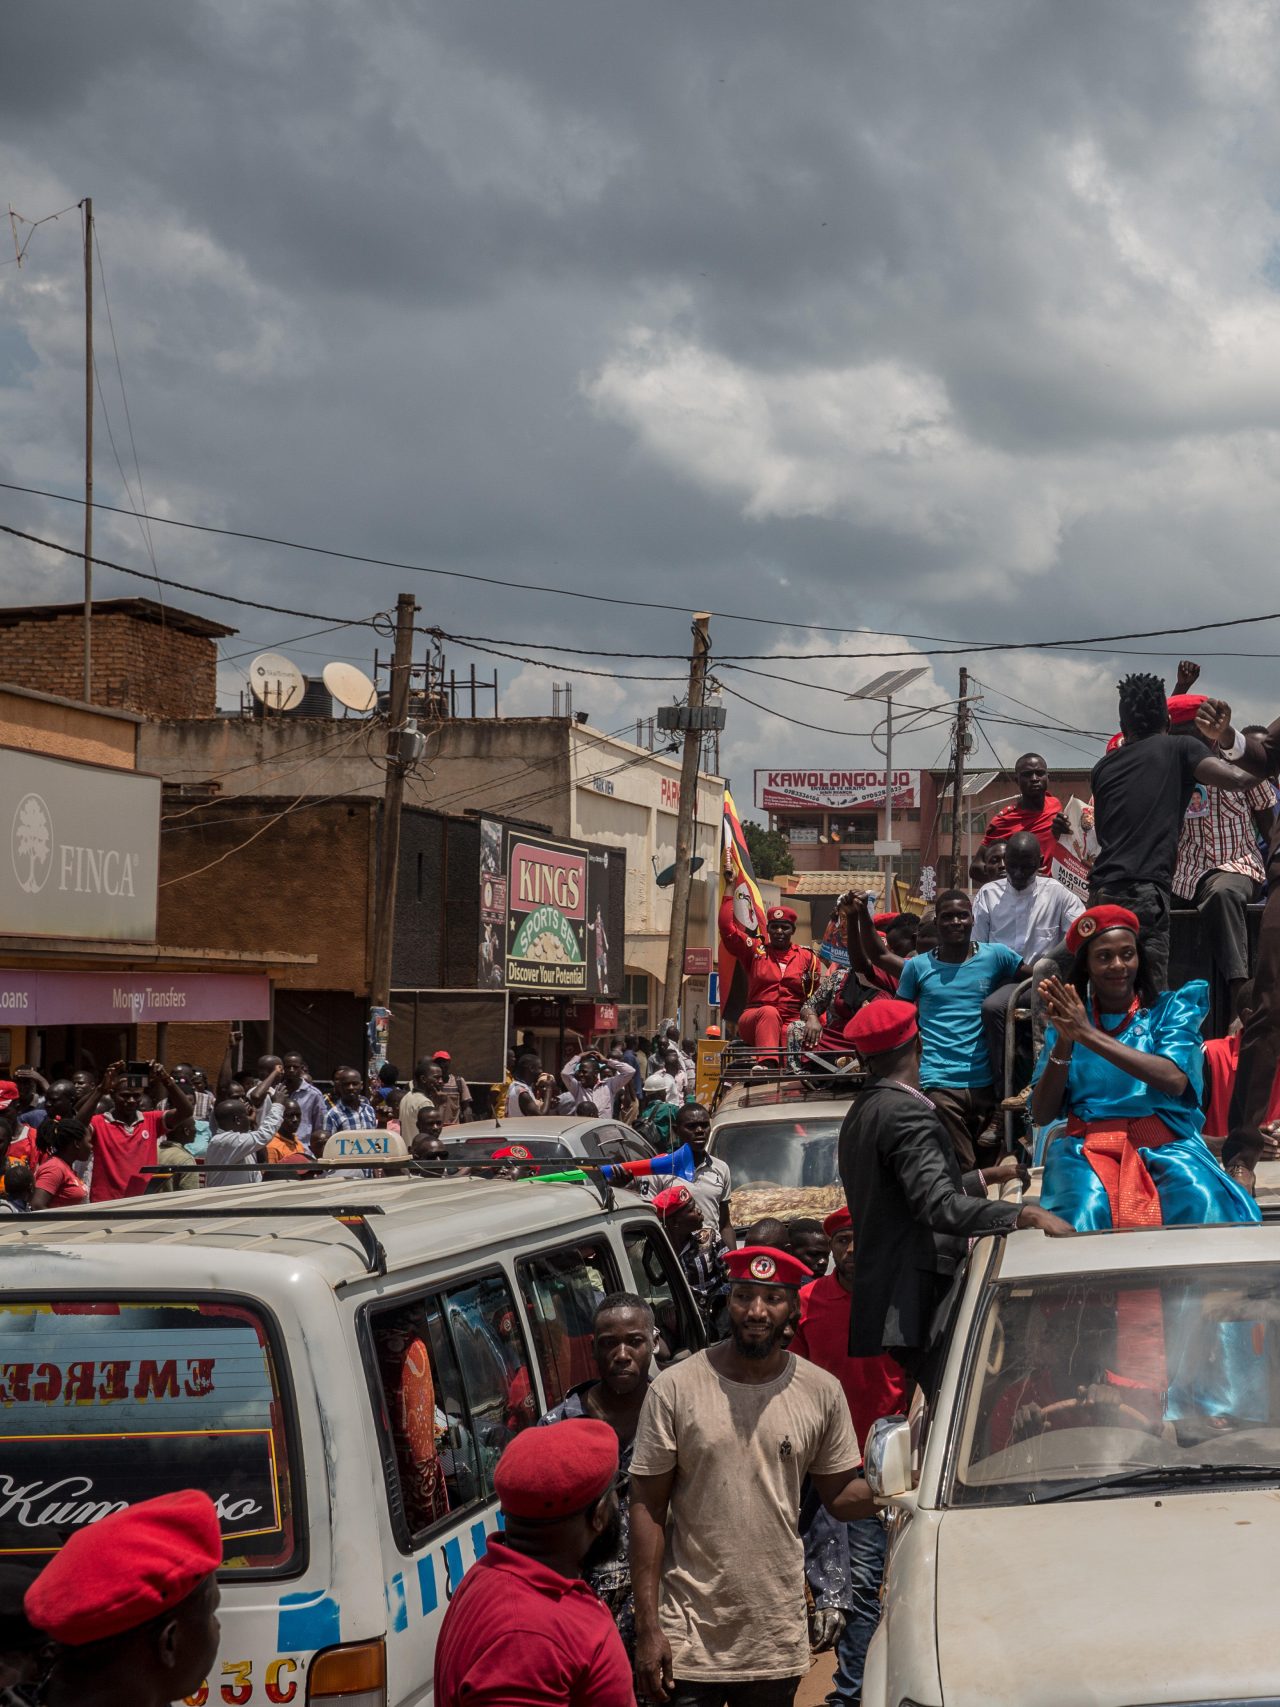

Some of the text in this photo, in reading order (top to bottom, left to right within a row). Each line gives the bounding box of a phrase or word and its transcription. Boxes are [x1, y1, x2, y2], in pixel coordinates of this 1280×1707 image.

[58, 845, 136, 897] FINCA
[519, 858, 580, 910] KINGS
[1058, 866, 1090, 893] MISSIO
[520, 907, 580, 959] SPORTS BET
[508, 961, 584, 985] Discover Your Potential
[0, 991, 28, 1009] oans
[112, 987, 187, 1012] Money Transfers
[336, 1137, 390, 1155] TAXI
